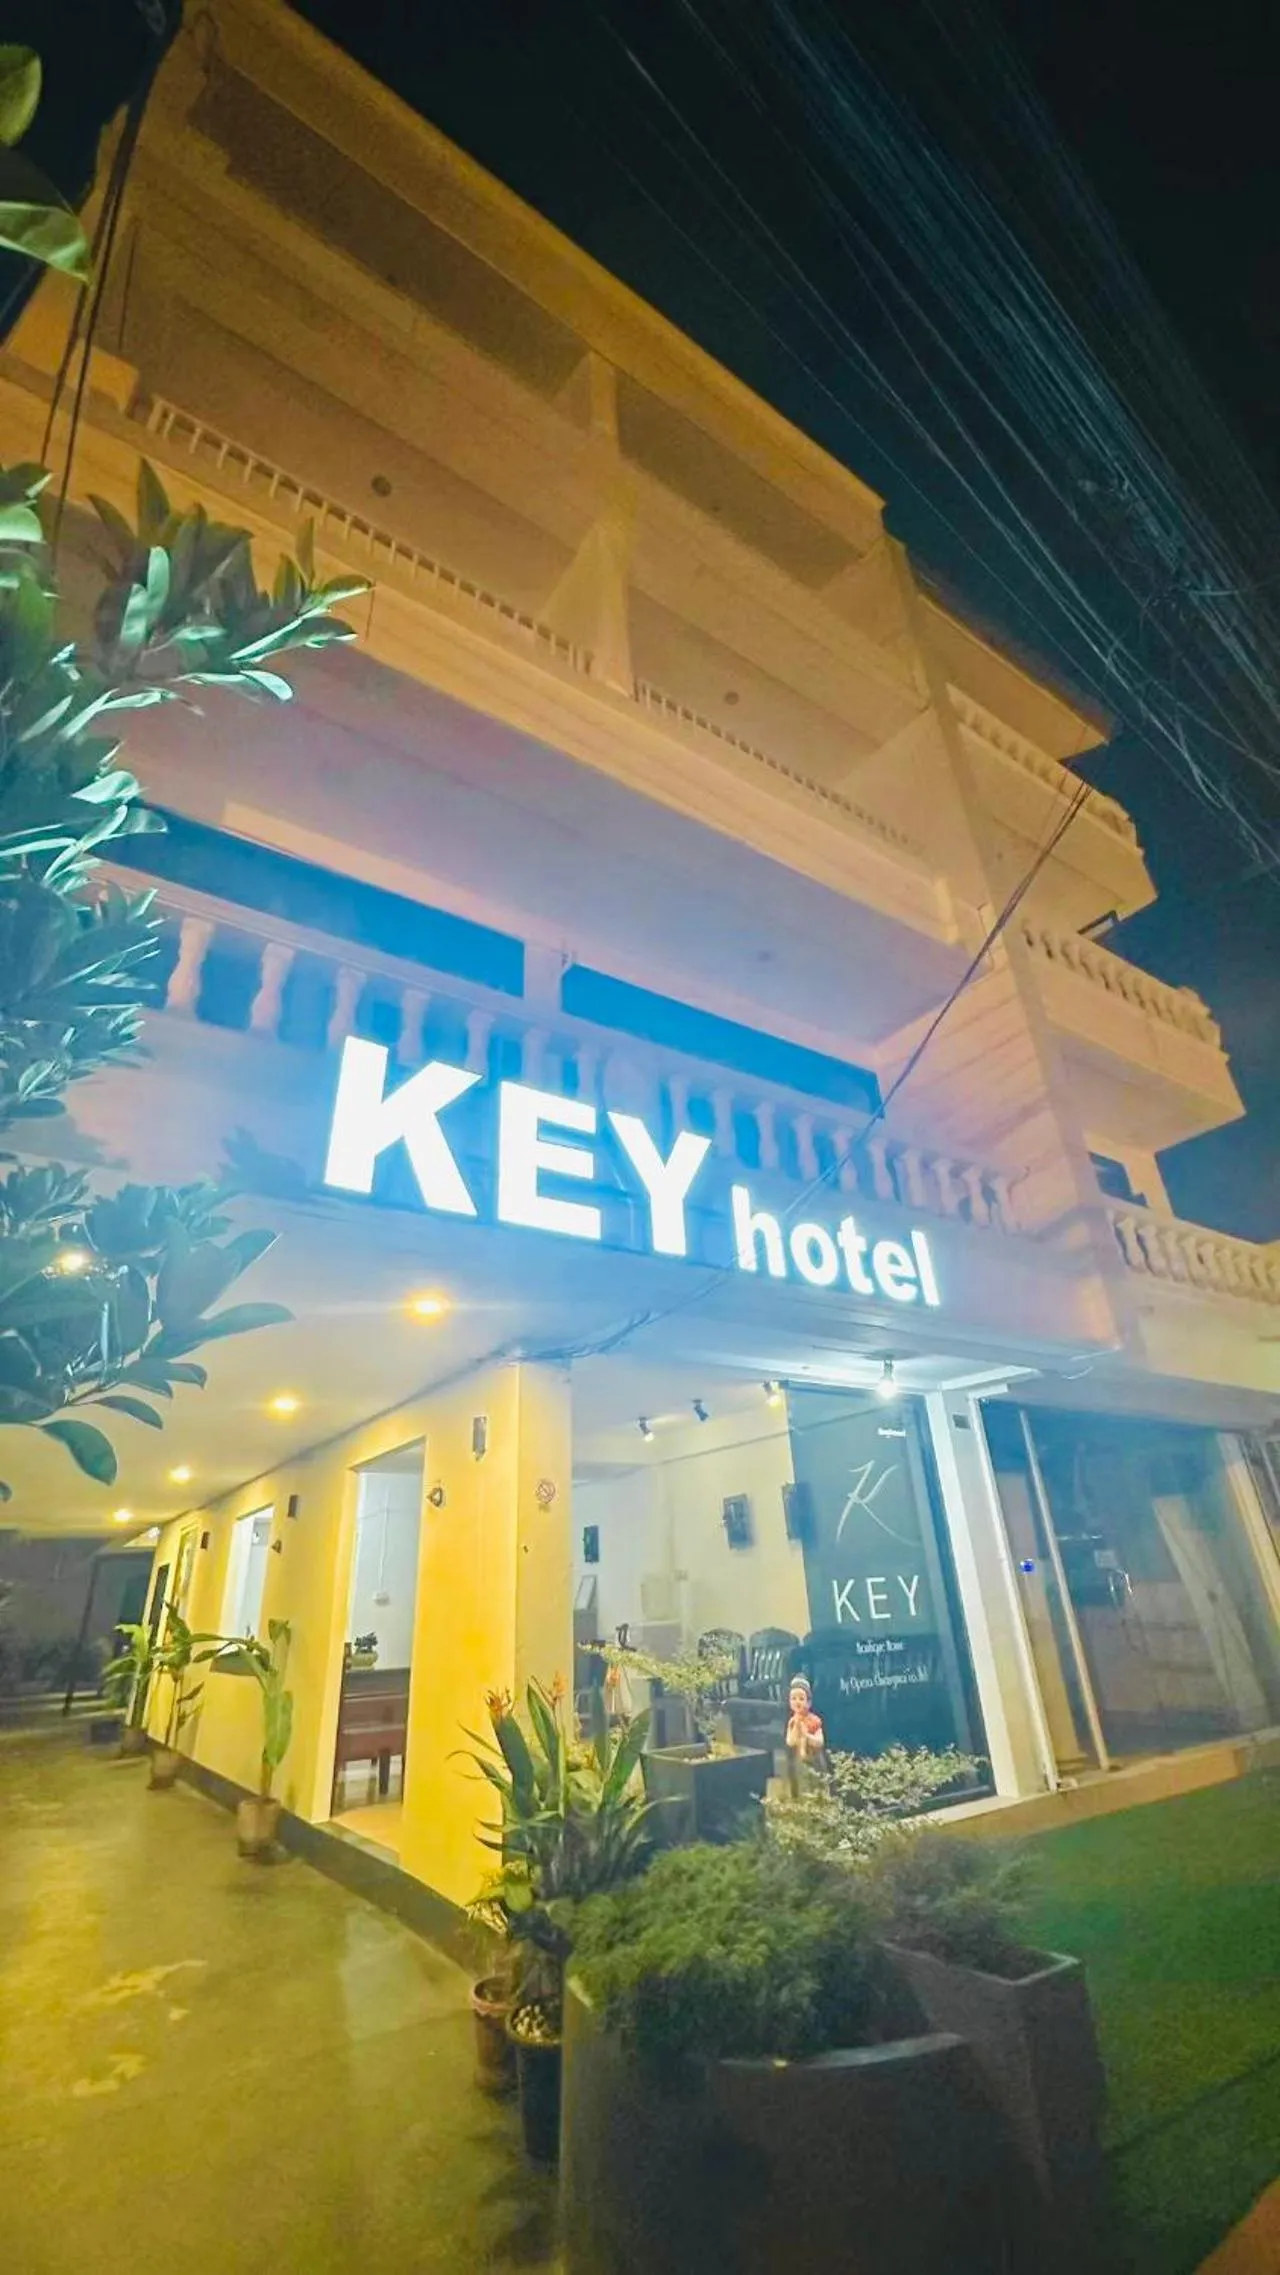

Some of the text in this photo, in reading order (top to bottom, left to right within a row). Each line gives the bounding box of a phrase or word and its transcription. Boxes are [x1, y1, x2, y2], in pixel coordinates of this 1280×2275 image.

[323, 1035, 940, 1305] KEY hotel
[832, 1575, 919, 1623] KEY
